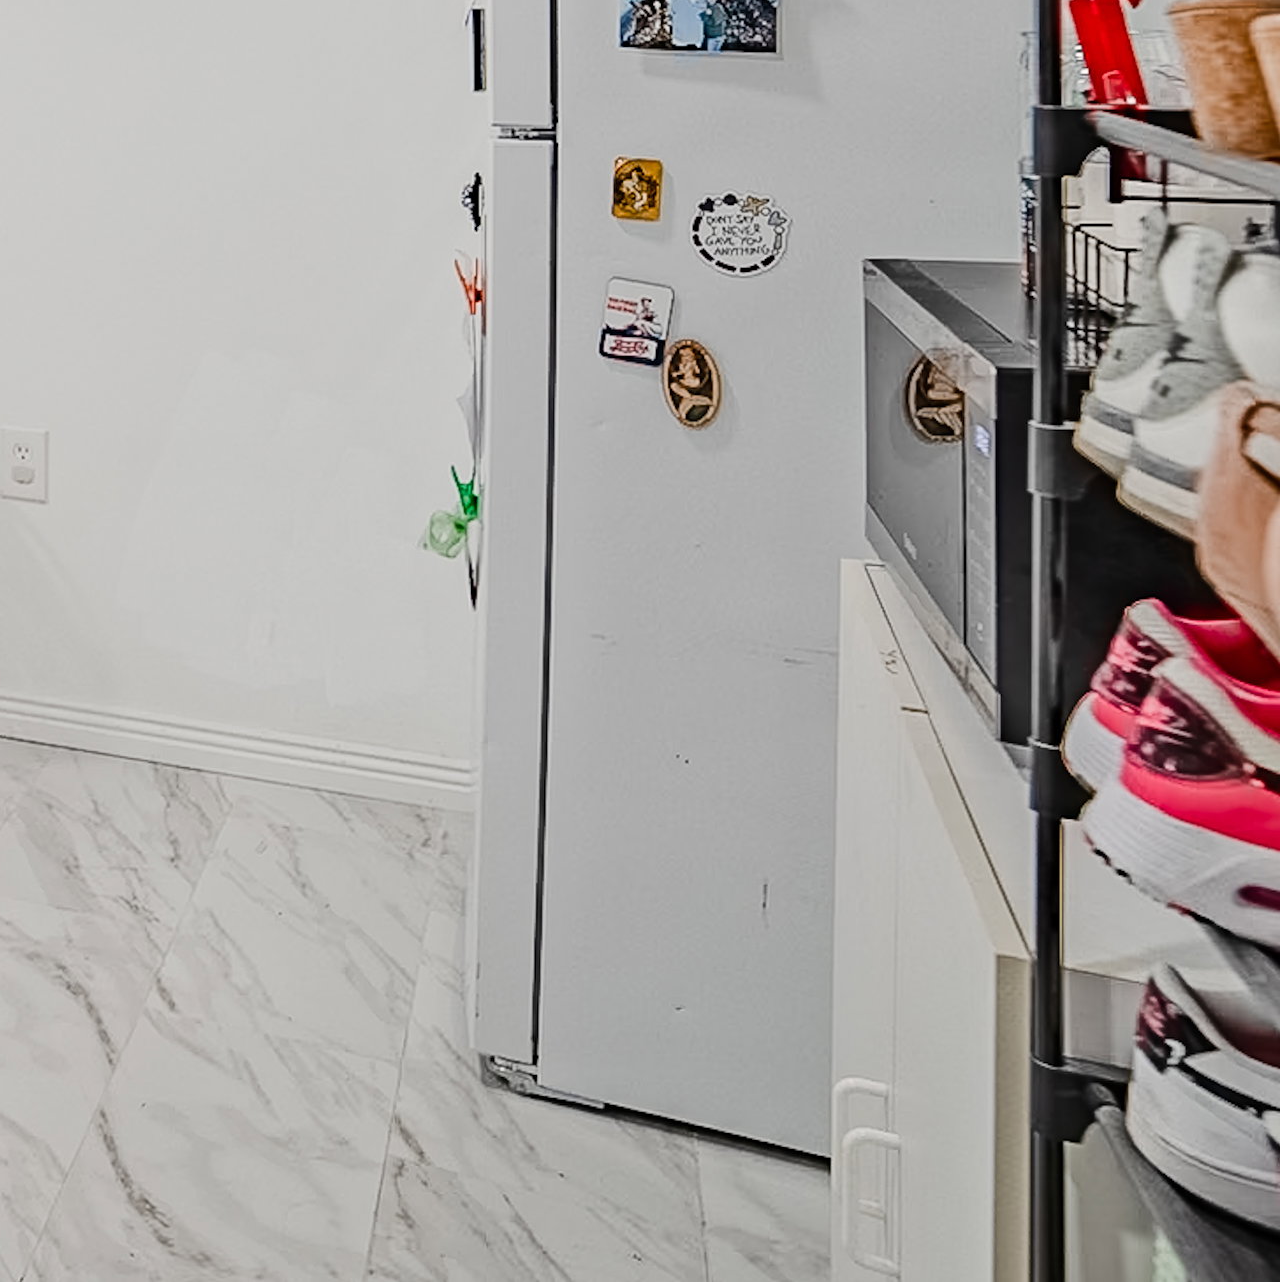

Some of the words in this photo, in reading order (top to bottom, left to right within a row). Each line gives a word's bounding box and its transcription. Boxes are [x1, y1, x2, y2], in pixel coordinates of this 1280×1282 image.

[721, 223, 760, 236] NEVER
[705, 235, 735, 246] GAVE
[740, 235, 763, 246] YOU
[713, 244, 770, 256] ANYTHING
